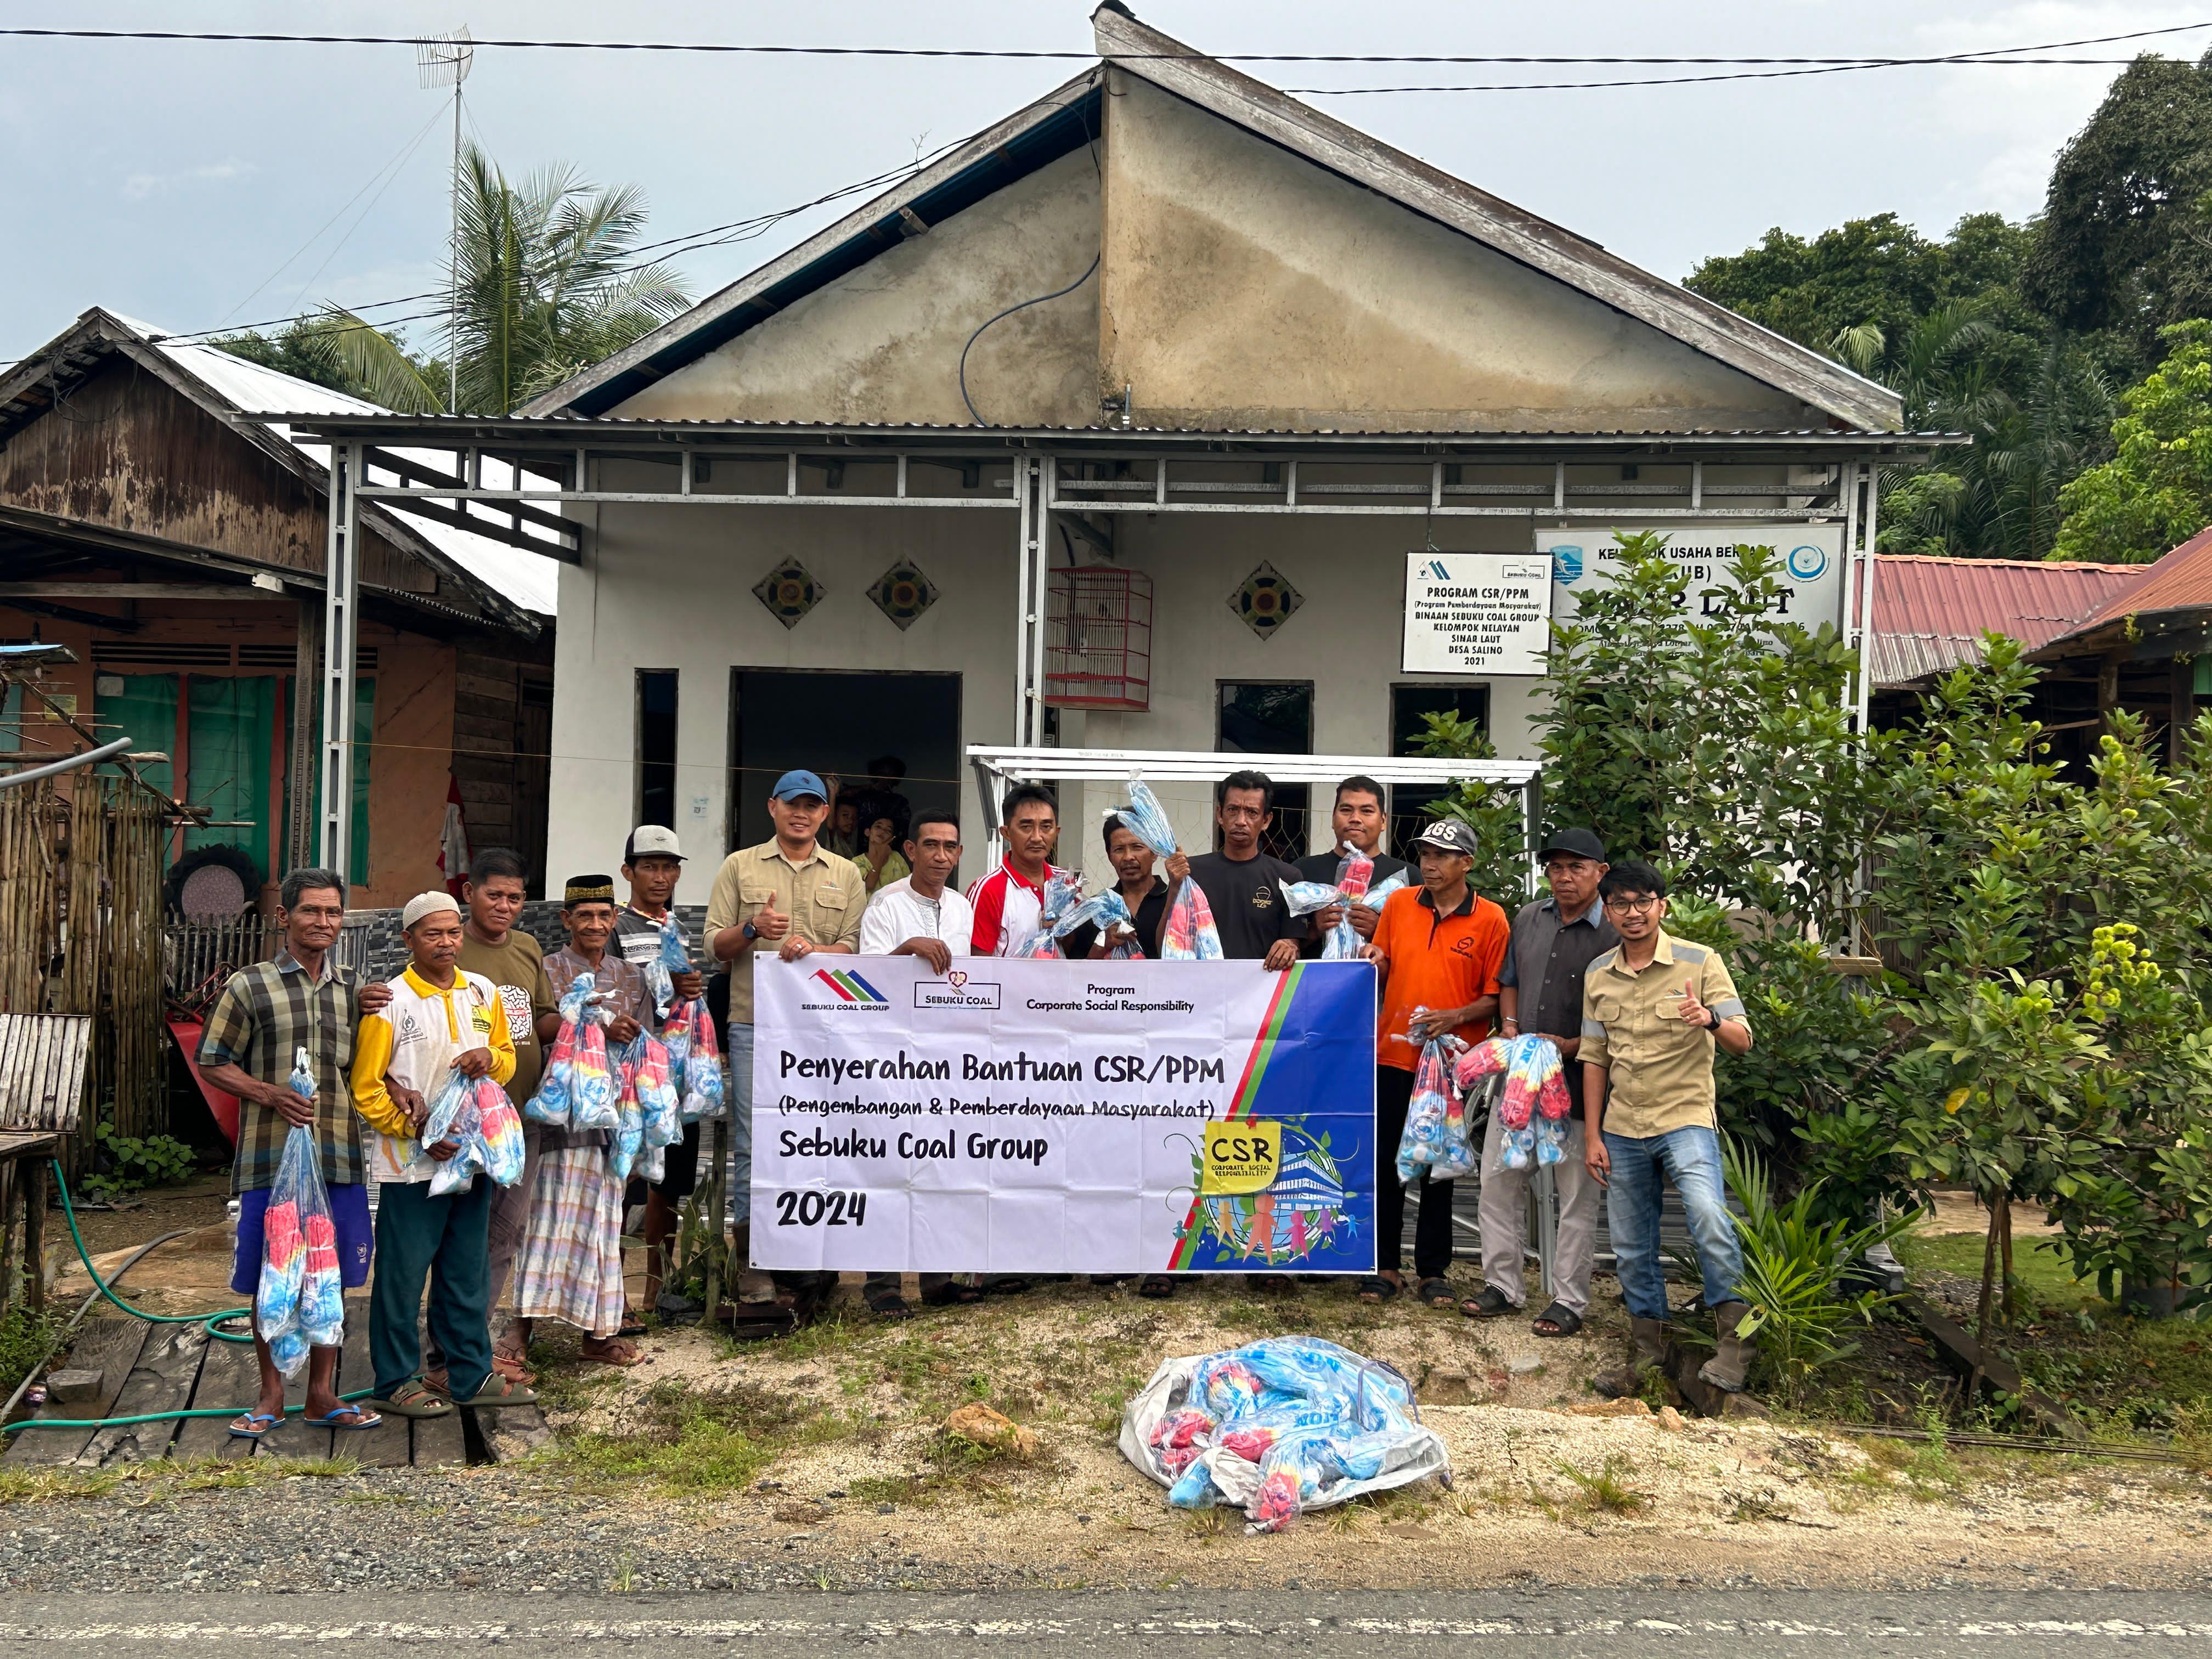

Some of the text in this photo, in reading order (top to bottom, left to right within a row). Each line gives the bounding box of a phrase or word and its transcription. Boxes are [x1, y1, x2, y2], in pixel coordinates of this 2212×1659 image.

[1670, 547, 1712, 558] USAHA
[1427, 587, 1529, 600] PROGRAM CSR/PPM
[1415, 611, 1539, 622] BINAAN SEBUKU COAL GROUP
[1434, 623, 1479, 631] KELOMPOK
[1448, 645, 1469, 653] DESA
[1464, 657, 1485, 665] 2021
[1087, 984, 1135, 996] Program
[926, 995, 992, 1005] SEBUKU COAL
[1026, 998, 1194, 1014] Corporate Social Responsibility
[780, 1050, 1224, 1085] Penyerahan Bantuan CSR/PPM
[778, 1094, 1215, 1121] (Pengembangan & Pemberdayaan Masyarakat)
[780, 1127, 1048, 1166] Sebuku Coal Group
[1211, 1138, 1273, 1163] CSR
[776, 1190, 867, 1226] 2024
